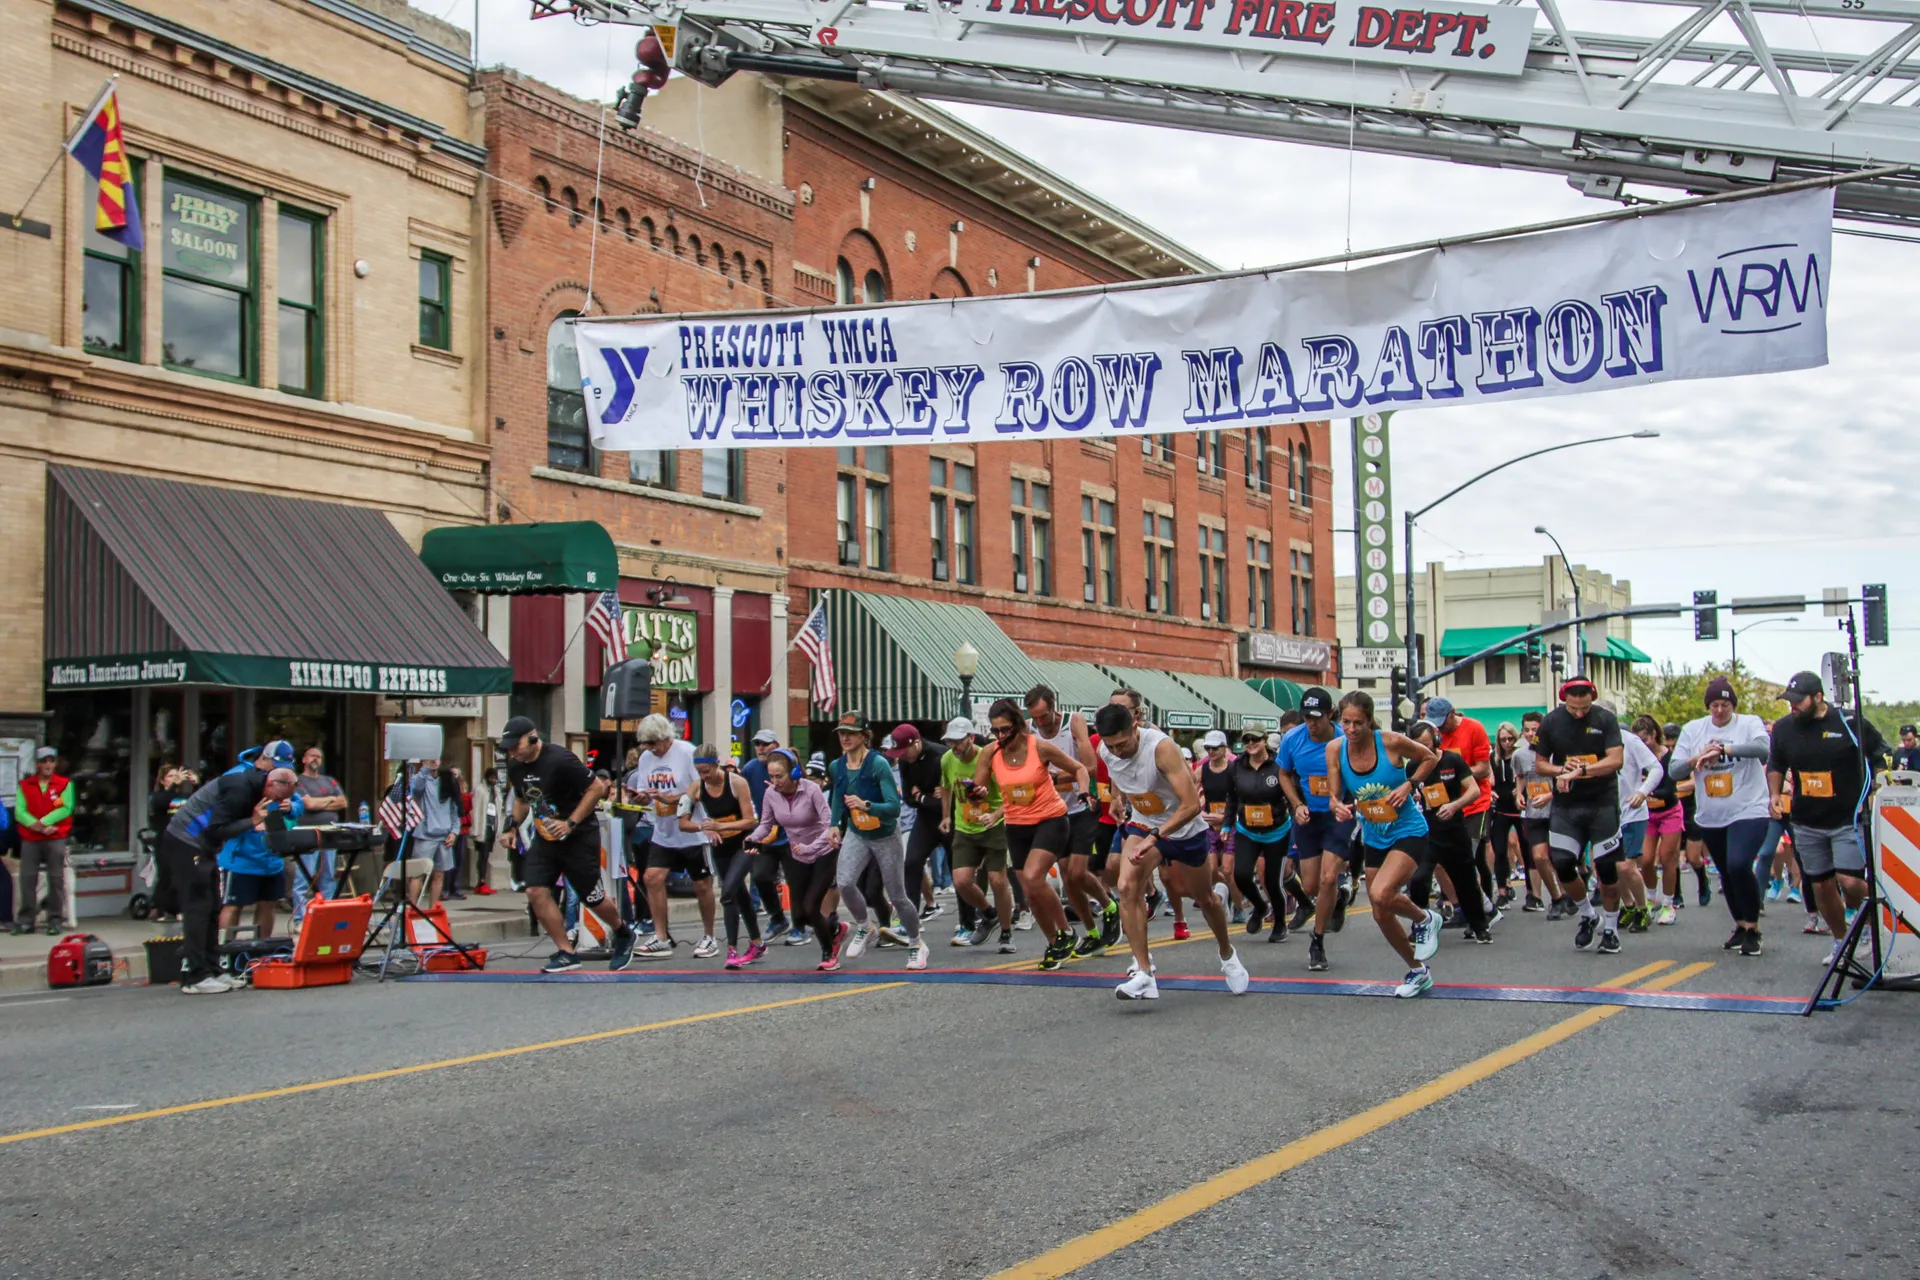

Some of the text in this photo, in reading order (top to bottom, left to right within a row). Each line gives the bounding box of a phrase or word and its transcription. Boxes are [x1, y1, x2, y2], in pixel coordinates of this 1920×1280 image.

[986, 0, 1496, 59] SCOTT FIRE DEPT.
[171, 193, 239, 225] JERSEY
[171, 227, 238, 260] SALOON
[1687, 253, 1823, 324] WRM
[679, 317, 897, 368] PRESCOTT YMCA
[680, 284, 1667, 440] WHISKEY ROW MARATHON
[624, 402, 639, 423] YMCA
[1366, 479, 1386, 641] MICHAEL
[495, 573, 525, 583] Whiskey
[526, 571, 543, 580] Row
[52, 659, 187, 685] Native American Jewelry
[289, 661, 448, 692] KIKKAPOO EXPRESS
[651, 654, 696, 686] OON
